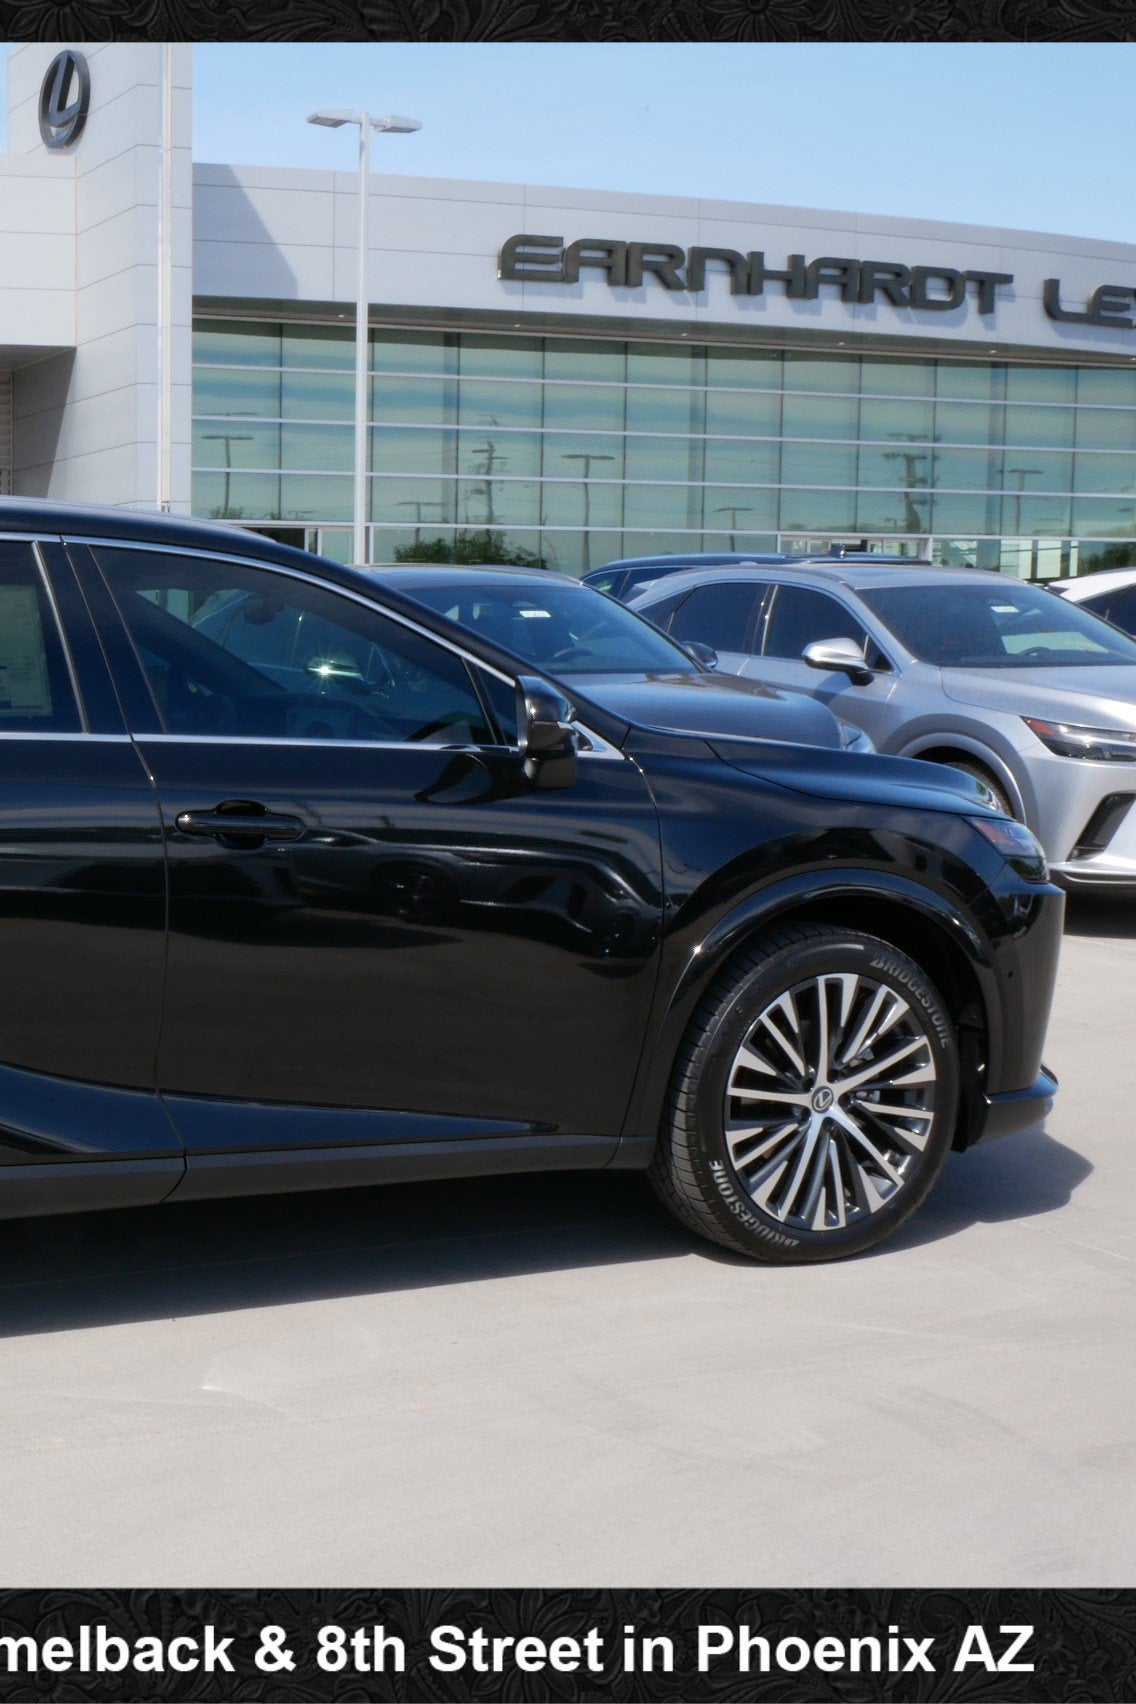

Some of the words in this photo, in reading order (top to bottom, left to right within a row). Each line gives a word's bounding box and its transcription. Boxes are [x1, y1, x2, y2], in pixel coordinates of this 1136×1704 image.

[497, 233, 1013, 315] EARNHARDT
[1042, 278, 1136, 329] LE
[869, 956, 955, 1048] BRIDGESTONE
[709, 1158, 801, 1248] BRIDGESTONE
